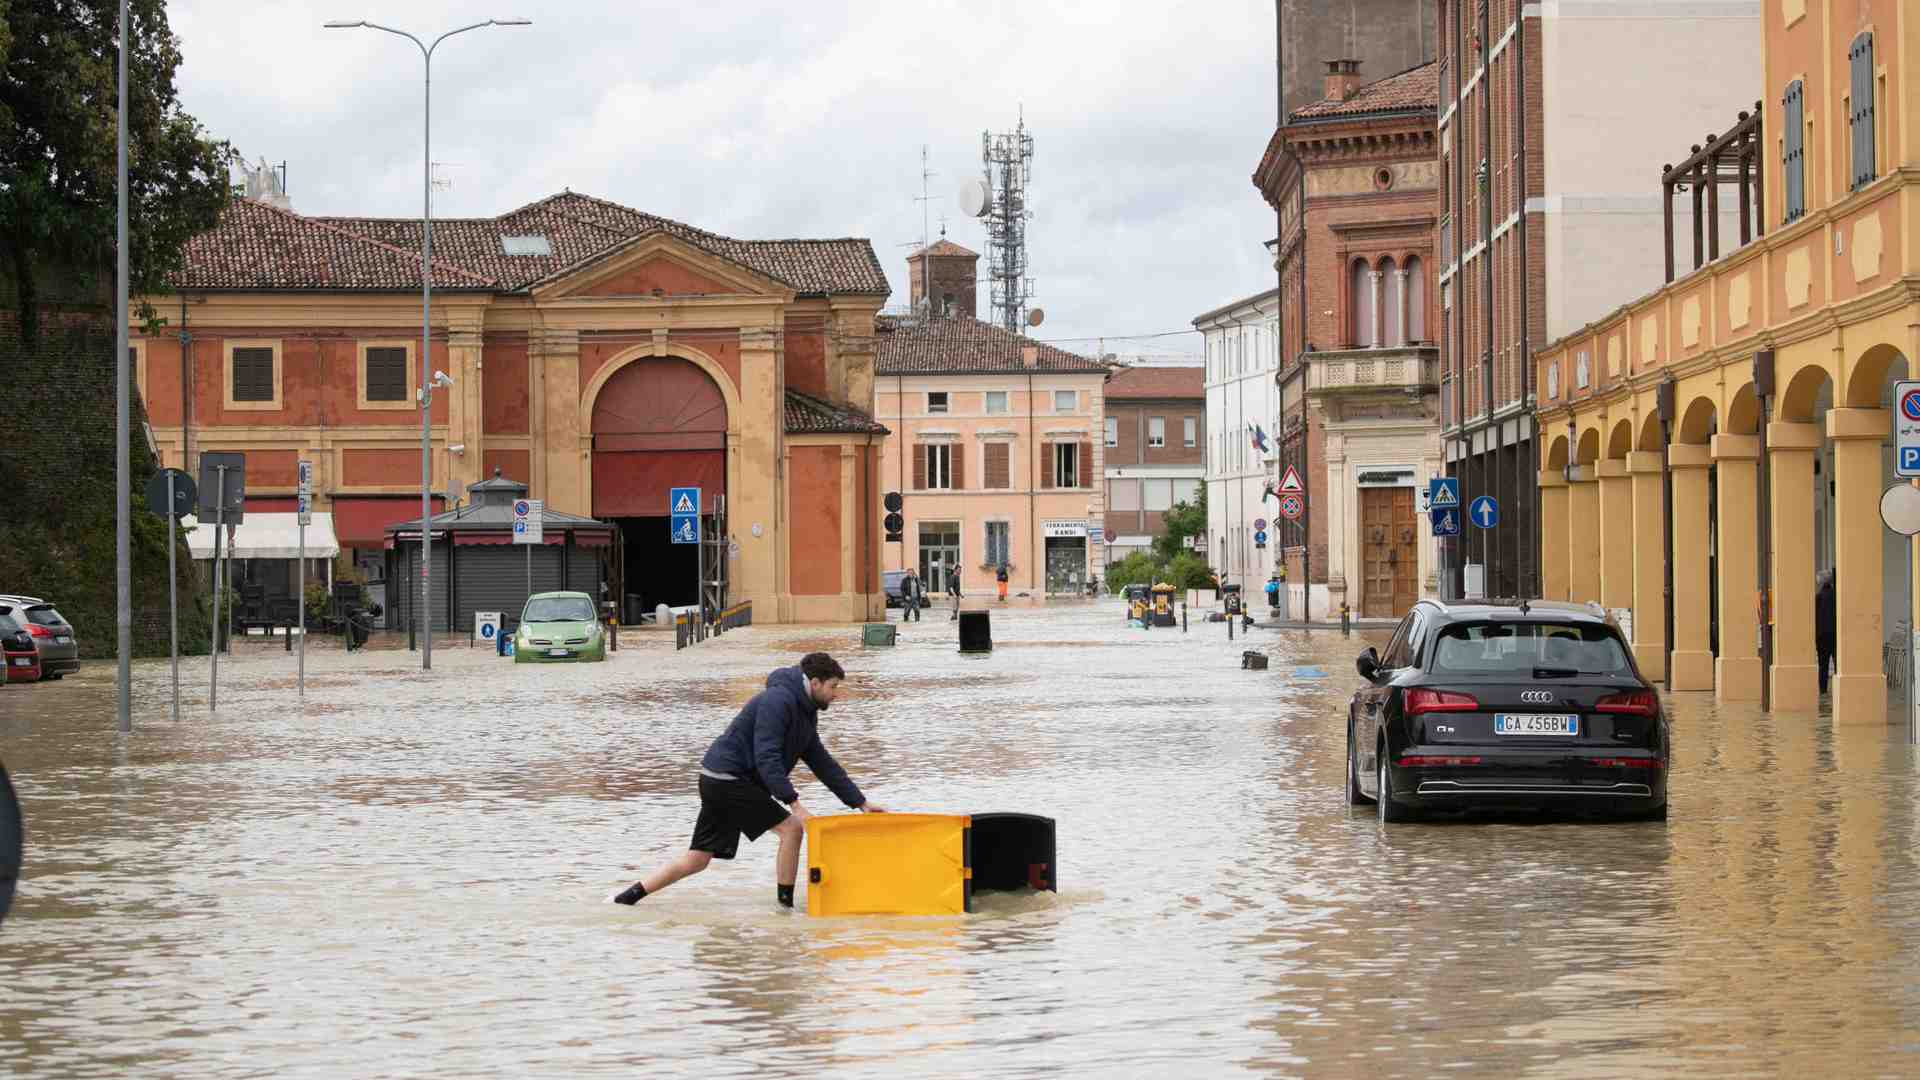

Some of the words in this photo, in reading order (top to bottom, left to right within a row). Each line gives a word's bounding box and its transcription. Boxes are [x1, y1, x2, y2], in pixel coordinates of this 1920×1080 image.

[1905, 449, 1918, 467] P
[1505, 716, 1520, 730] GA
[1527, 717, 1567, 730] 456BW
